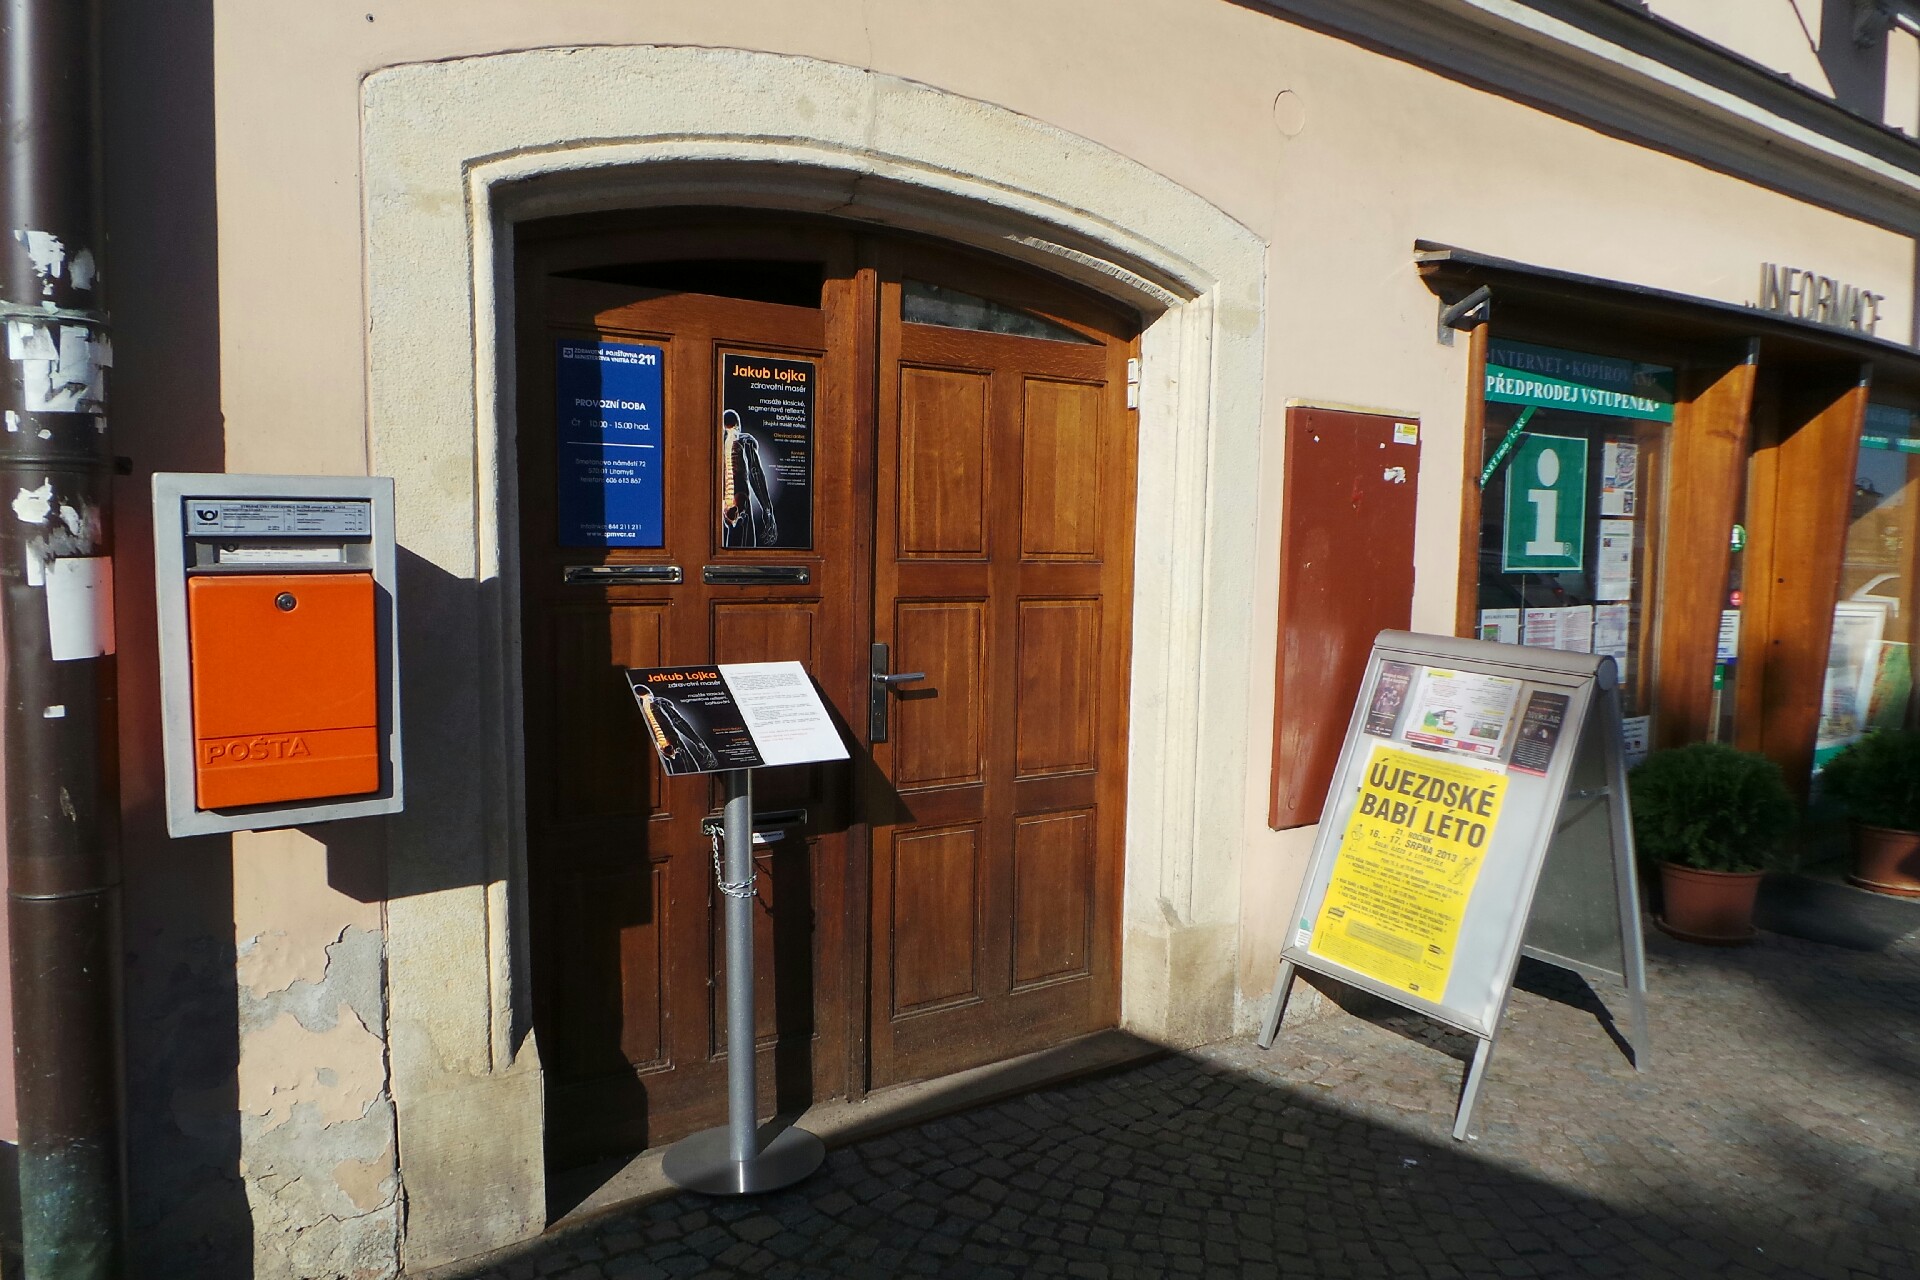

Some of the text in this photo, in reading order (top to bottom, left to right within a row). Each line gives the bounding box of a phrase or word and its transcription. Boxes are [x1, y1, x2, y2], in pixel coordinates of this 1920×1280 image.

[638, 353, 656, 366] 211
[732, 364, 806, 383] Jakub Lojka
[1486, 373, 1655, 412] PŘEDPRODEJ VSTUPENEK
[575, 398, 646, 411] PROVOZNÍ DOBA
[614, 421, 633, 429] 15.00
[633, 422, 650, 431] hod.
[647, 671, 718, 683] Jakub Lojka
[1369, 757, 1497, 818] ÚJEZDSKÉ
[1359, 792, 1487, 848] BABÍ LÉTO
[1369, 829, 1381, 840] 16.
[1389, 835, 1401, 846] 17.
[1404, 839, 1434, 856] SRPNA
[1435, 849, 1458, 863] 2013
